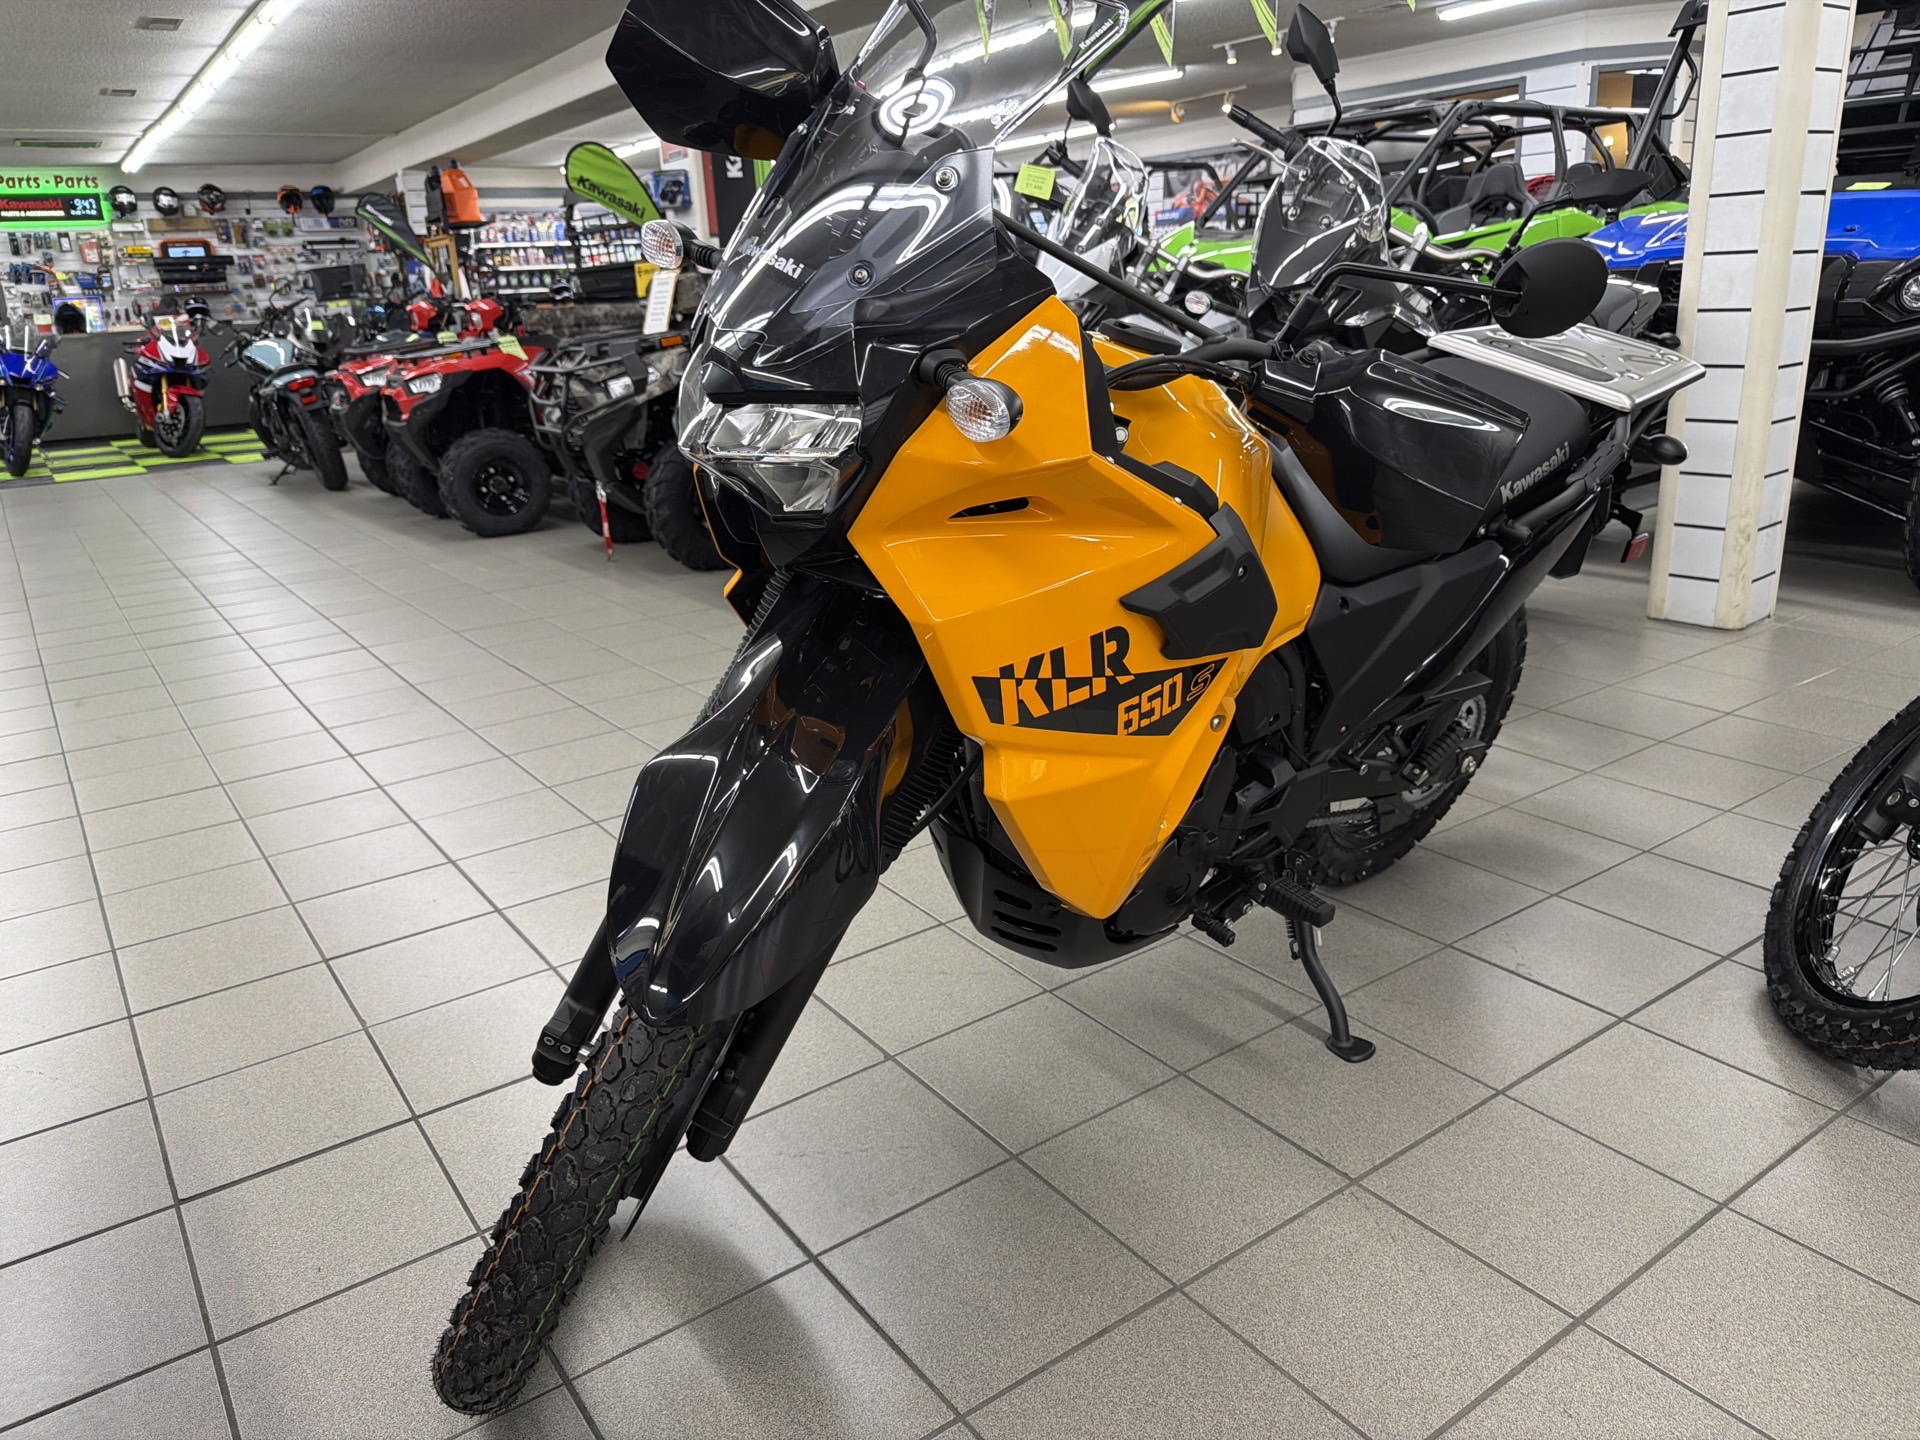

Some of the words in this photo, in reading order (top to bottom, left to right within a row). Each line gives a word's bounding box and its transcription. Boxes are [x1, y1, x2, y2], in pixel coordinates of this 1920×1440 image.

[1079, 18, 1114, 50] Kawasaki
[53, 174, 99, 189] Parts
[577, 175, 646, 219] Kawasaki
[1500, 441, 1570, 504] Kawasaki
[999, 625, 1136, 726] KLR
[1116, 671, 1183, 736] 650
[1186, 663, 1216, 702] S
